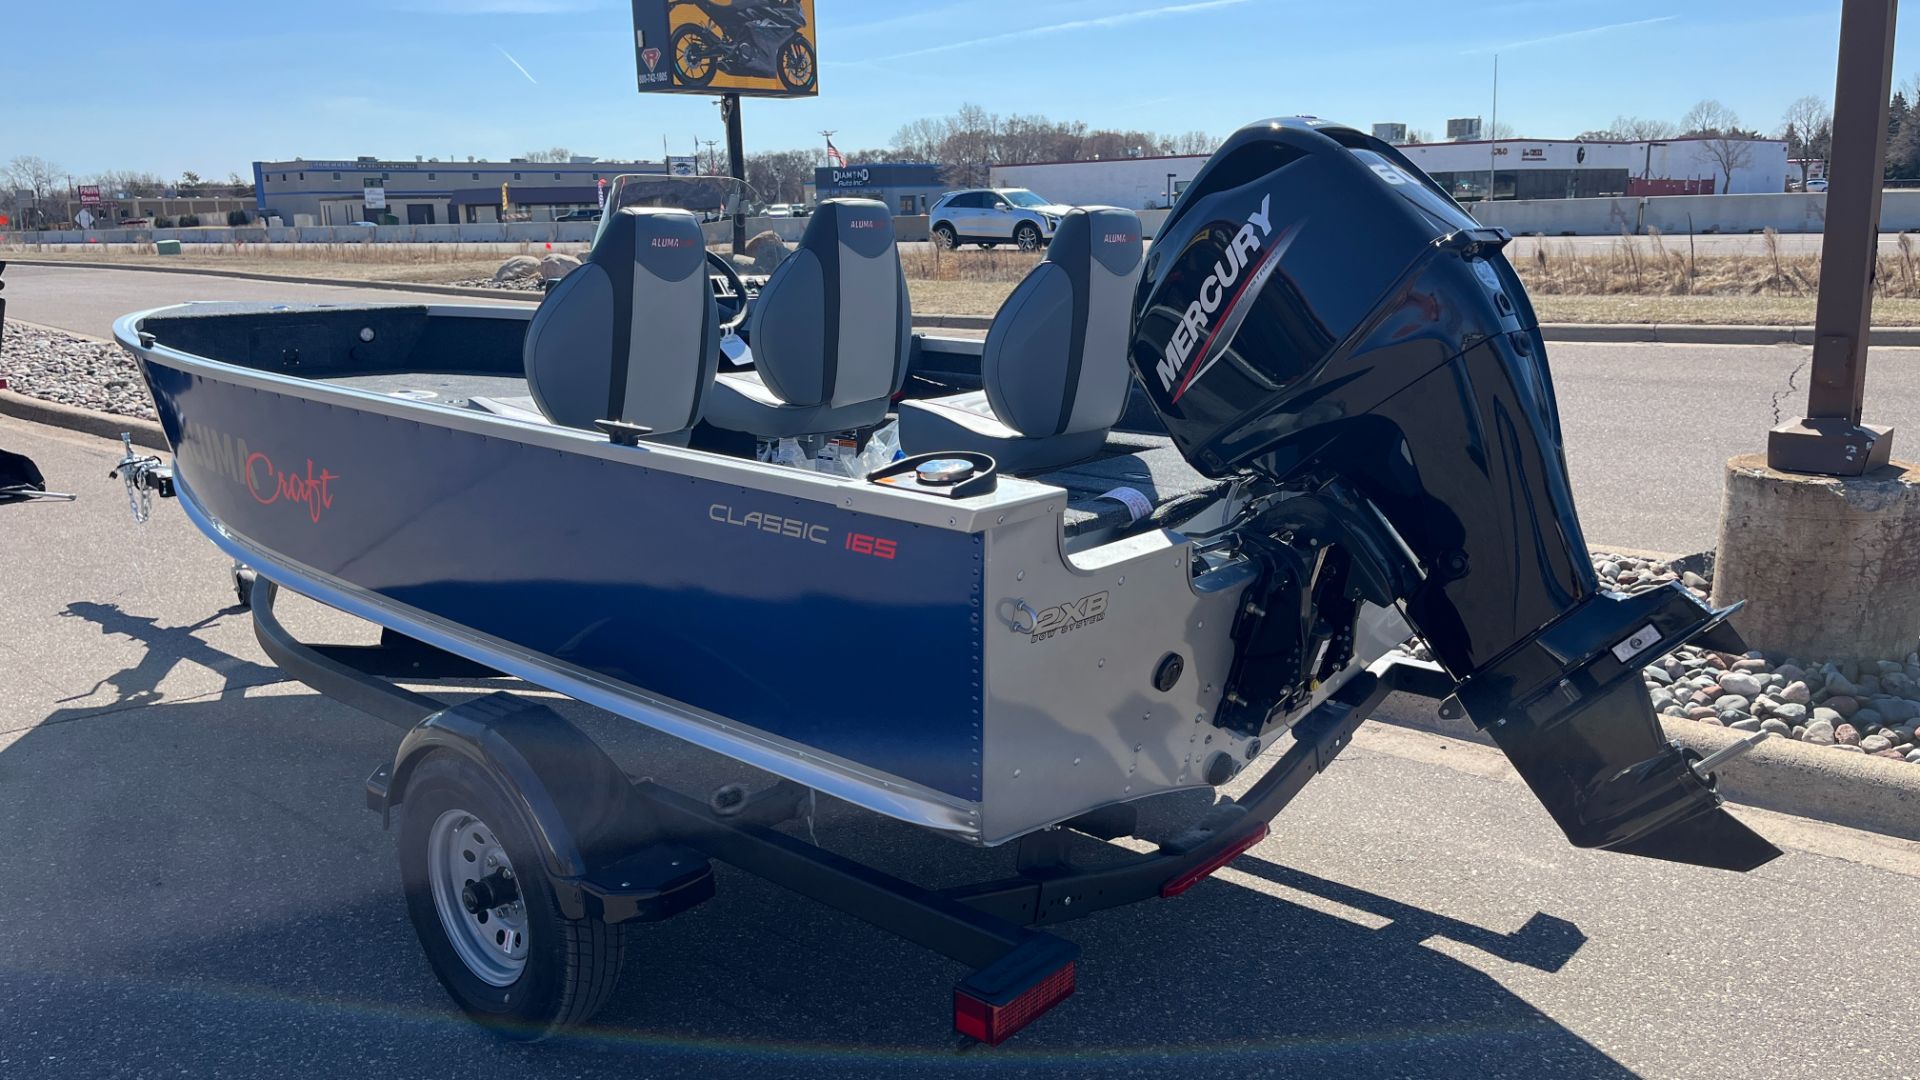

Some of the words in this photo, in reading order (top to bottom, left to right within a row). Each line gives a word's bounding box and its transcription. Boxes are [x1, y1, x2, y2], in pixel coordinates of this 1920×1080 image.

[1155, 193, 1273, 393] MERCURY
[246, 452, 340, 524] Craft
[708, 503, 829, 545] CLASSIC
[845, 532, 898, 560] 165
[1031, 631, 1056, 644] BOW
[1061, 612, 1106, 634] SYSTEM
[1034, 590, 1110, 635] 2XB
